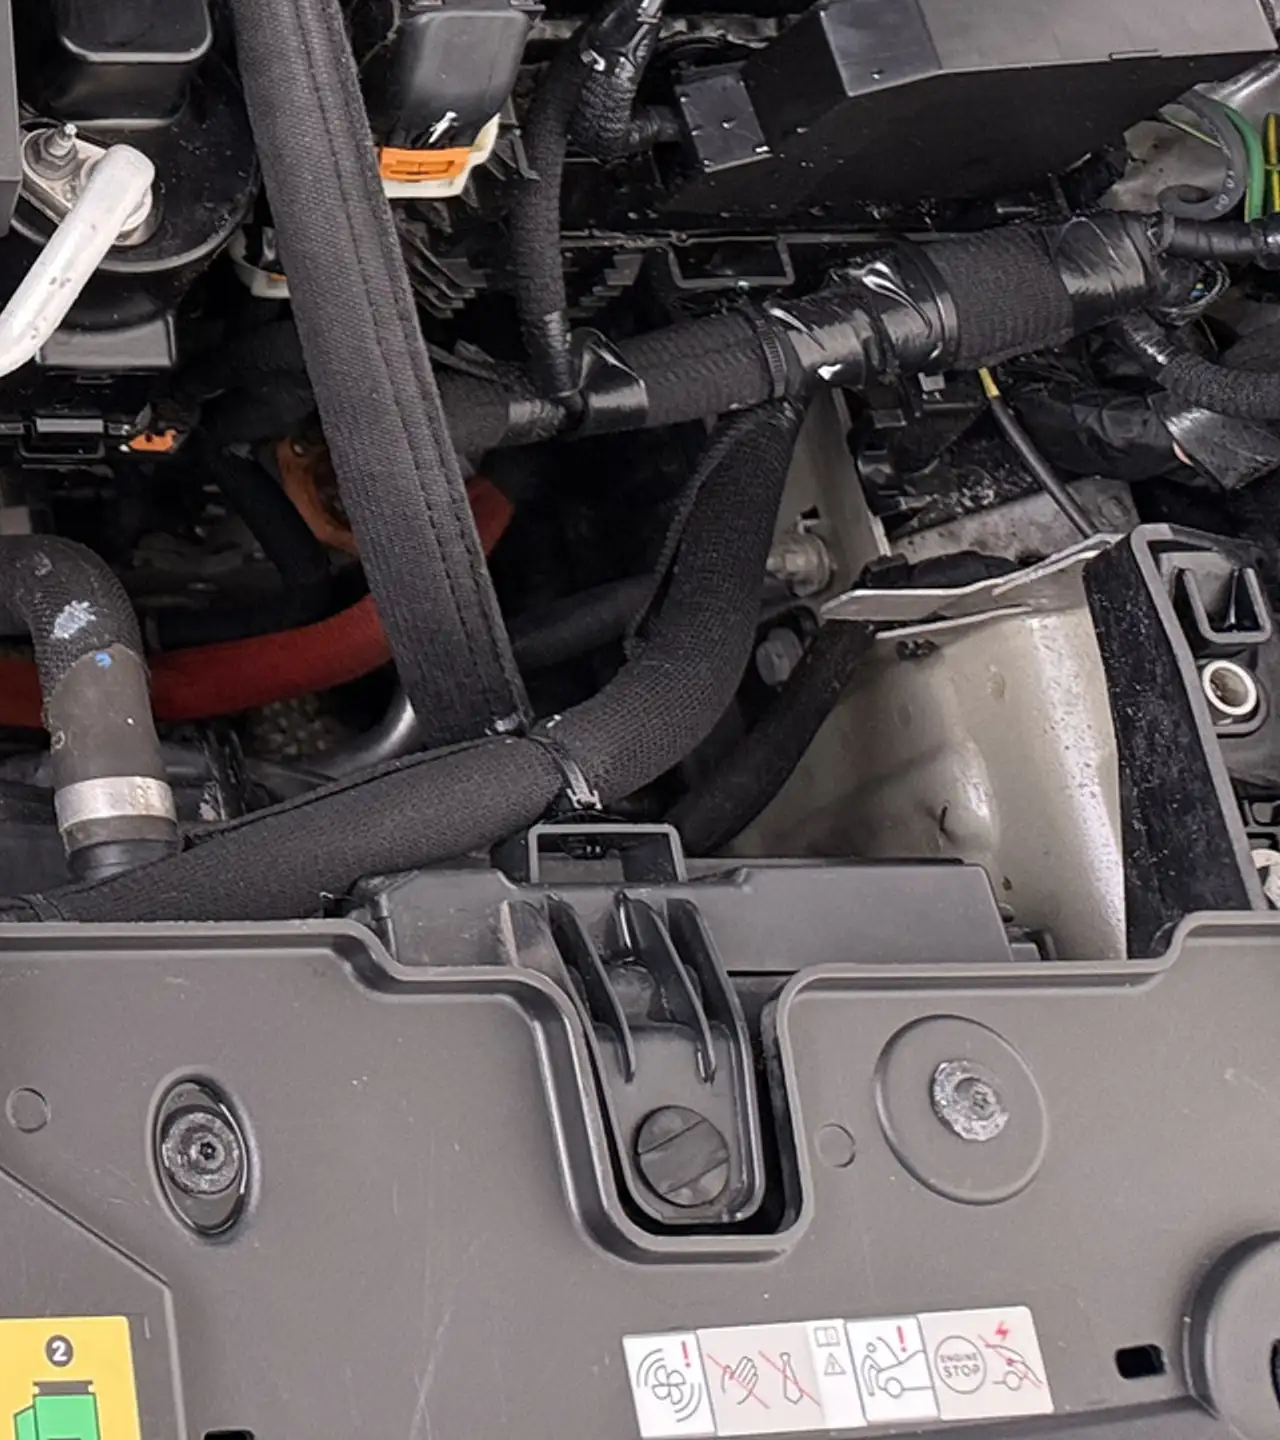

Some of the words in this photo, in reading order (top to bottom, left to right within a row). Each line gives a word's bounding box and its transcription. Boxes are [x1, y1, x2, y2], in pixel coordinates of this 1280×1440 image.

[51, 1340, 68, 1361] 2
[939, 1352, 979, 1364] ENGINE
[943, 1363, 981, 1379] STOP
